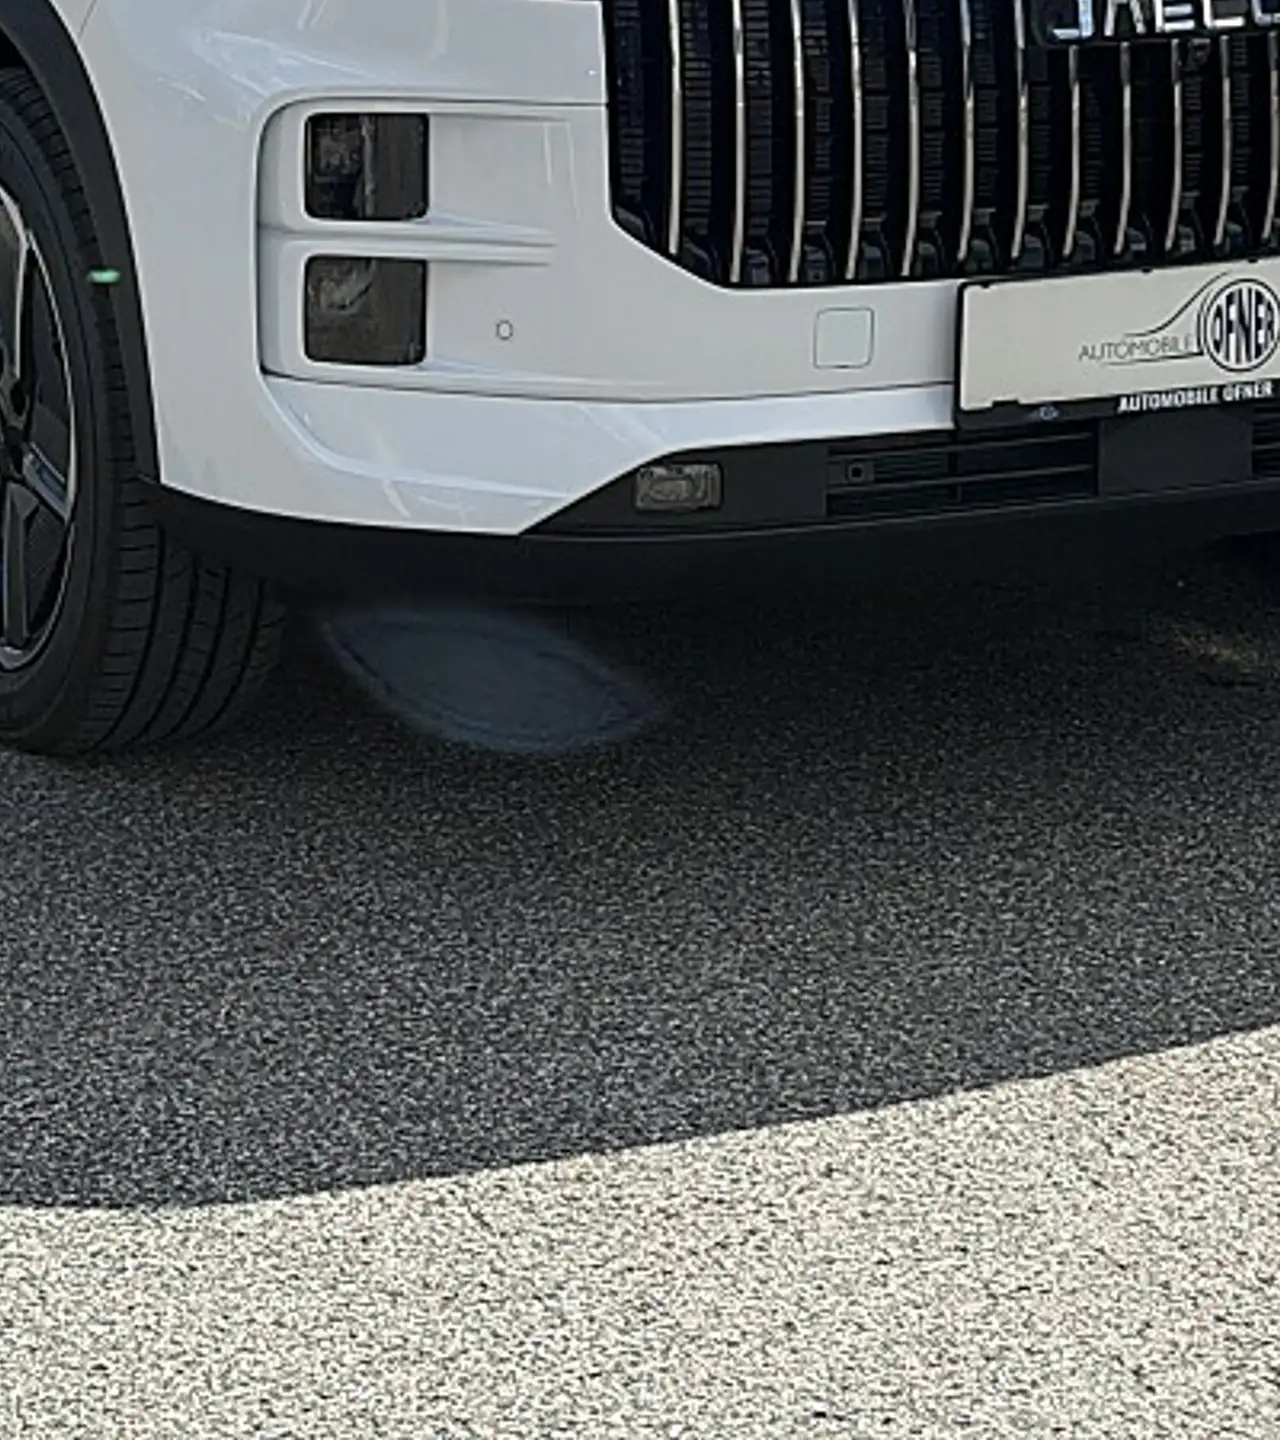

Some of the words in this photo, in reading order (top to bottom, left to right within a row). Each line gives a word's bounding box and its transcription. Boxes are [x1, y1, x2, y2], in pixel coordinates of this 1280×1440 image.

[1078, 333, 1195, 361] AUTOMOBILE
[1210, 286, 1276, 366] OFNER
[1117, 386, 1218, 413] AUTOMOBILE
[1223, 379, 1274, 403] OFNER
